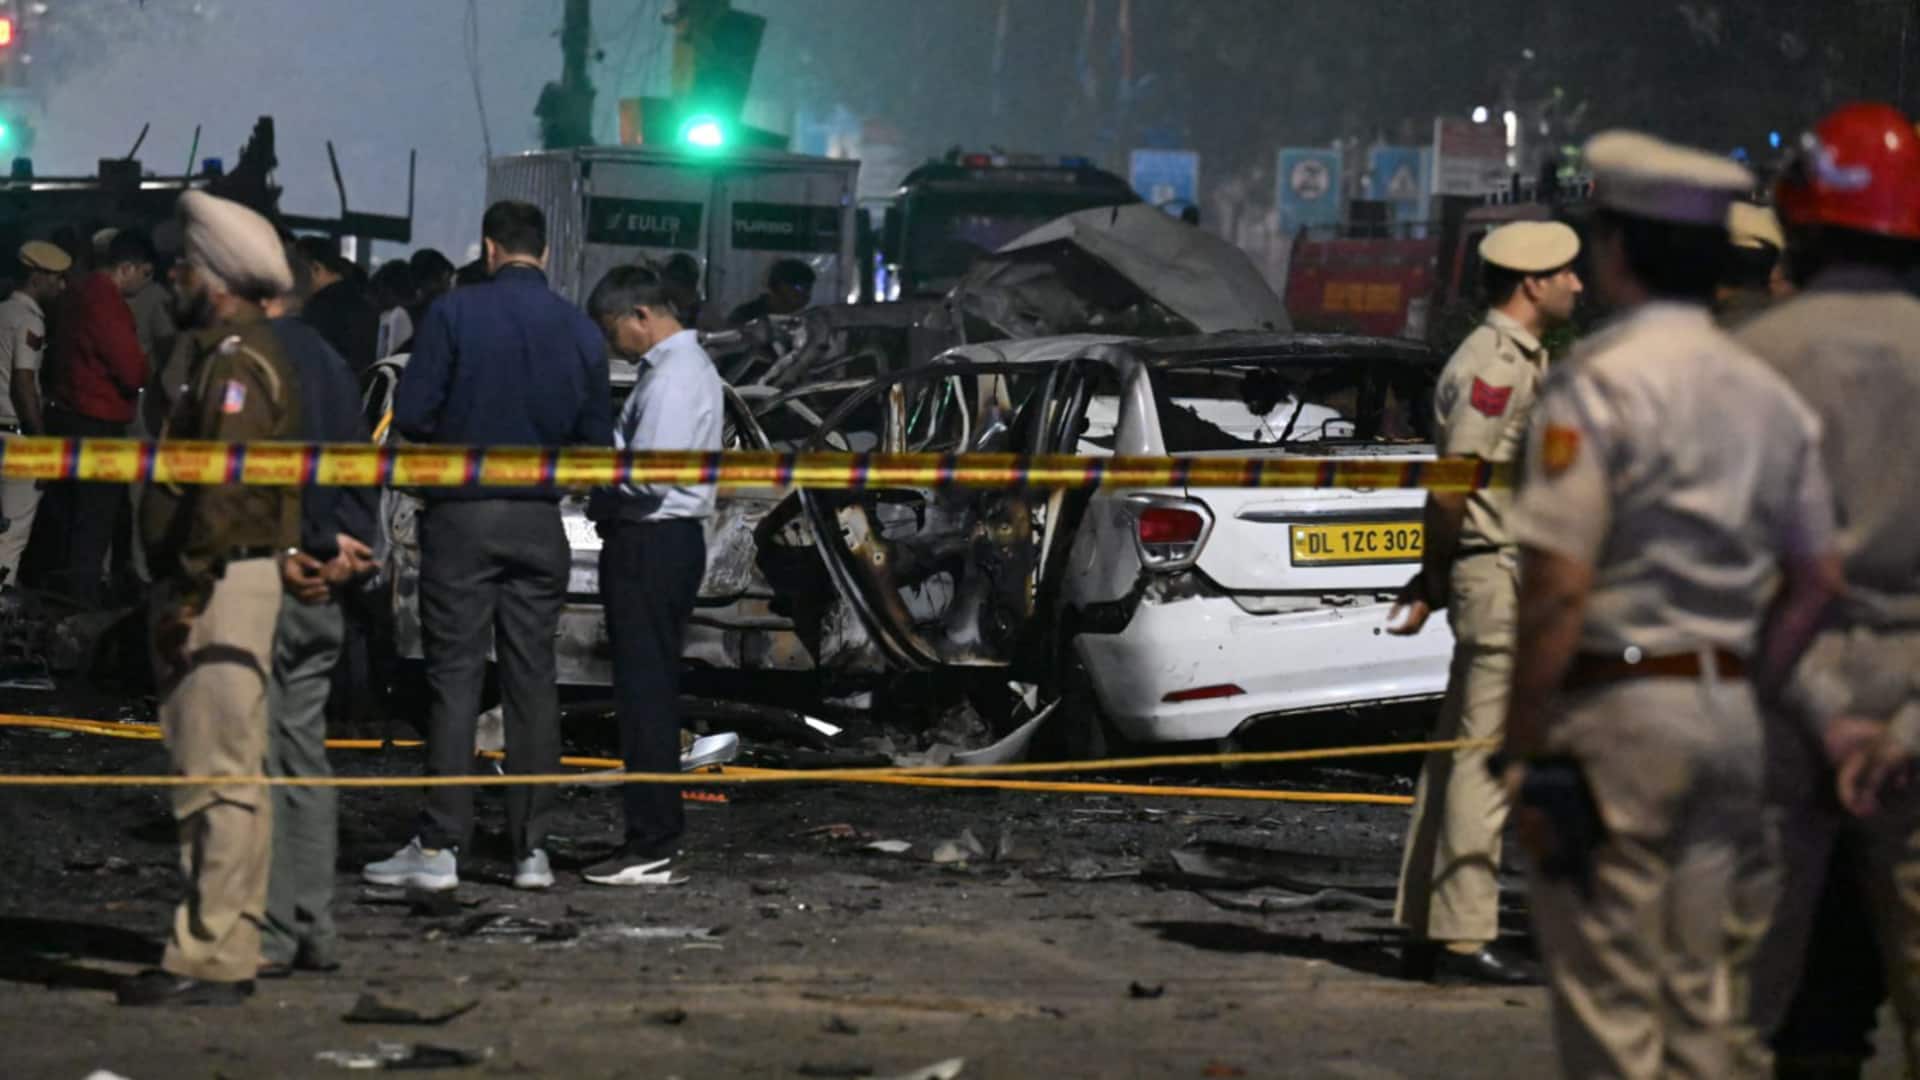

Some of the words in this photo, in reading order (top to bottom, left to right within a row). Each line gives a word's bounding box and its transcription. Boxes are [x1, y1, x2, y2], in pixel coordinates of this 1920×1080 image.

[627, 213, 681, 233] EULER
[1308, 532, 1335, 554] DL
[1341, 530, 1378, 553] 1ZC
